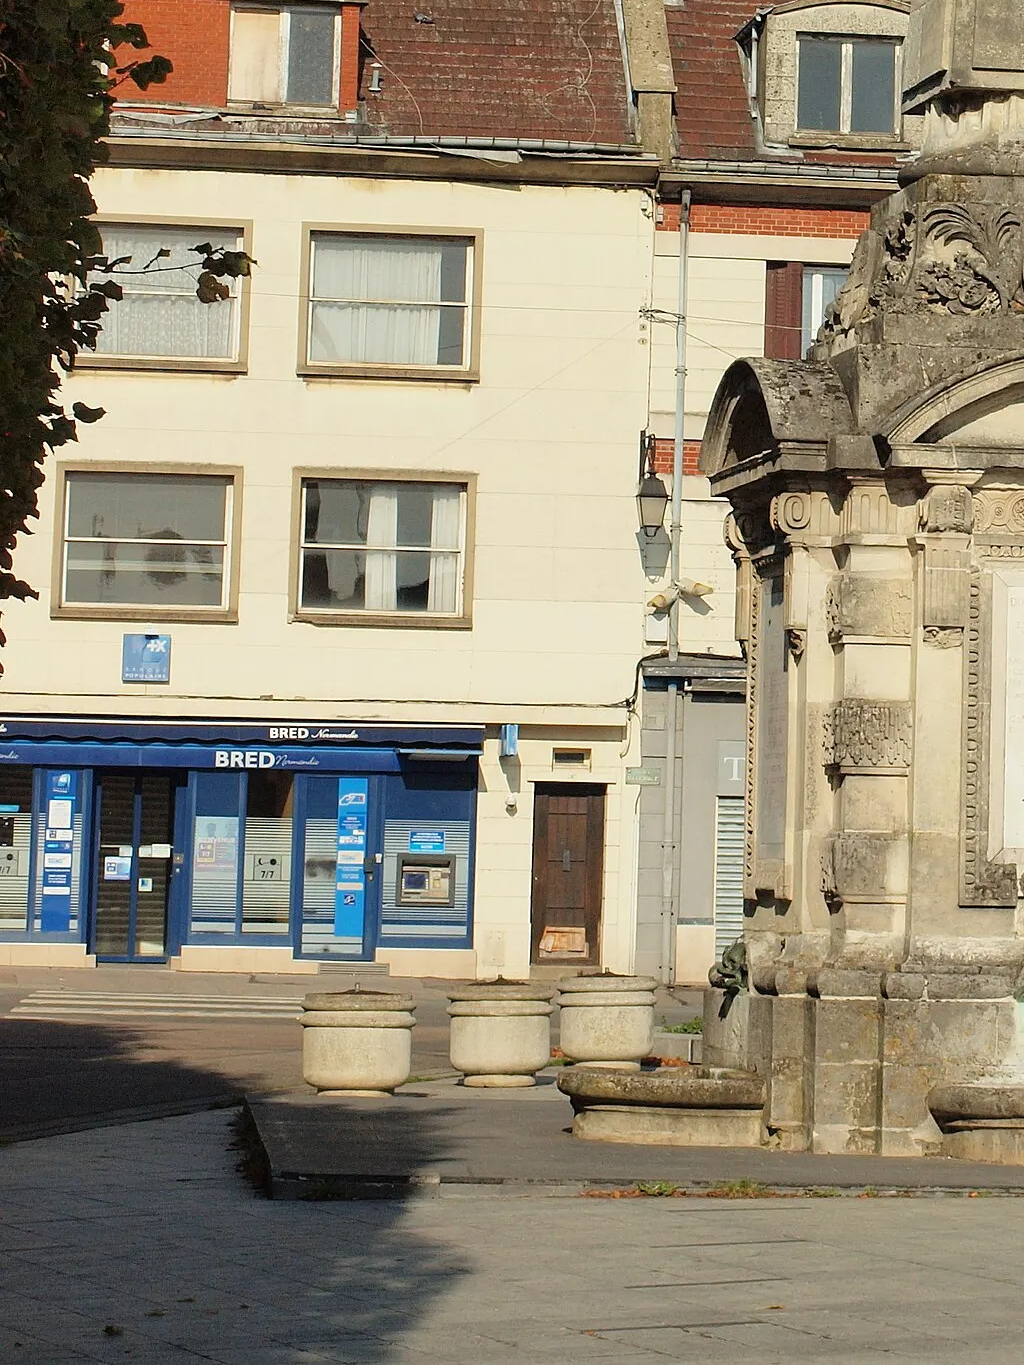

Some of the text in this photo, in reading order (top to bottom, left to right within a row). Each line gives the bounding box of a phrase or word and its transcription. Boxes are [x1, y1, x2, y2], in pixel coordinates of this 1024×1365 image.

[269, 727, 359, 740] BRED Normandie
[214, 750, 320, 769] BRED Normandie
[723, 757, 745, 781] T
[260, 870, 274, 880] 7/7
